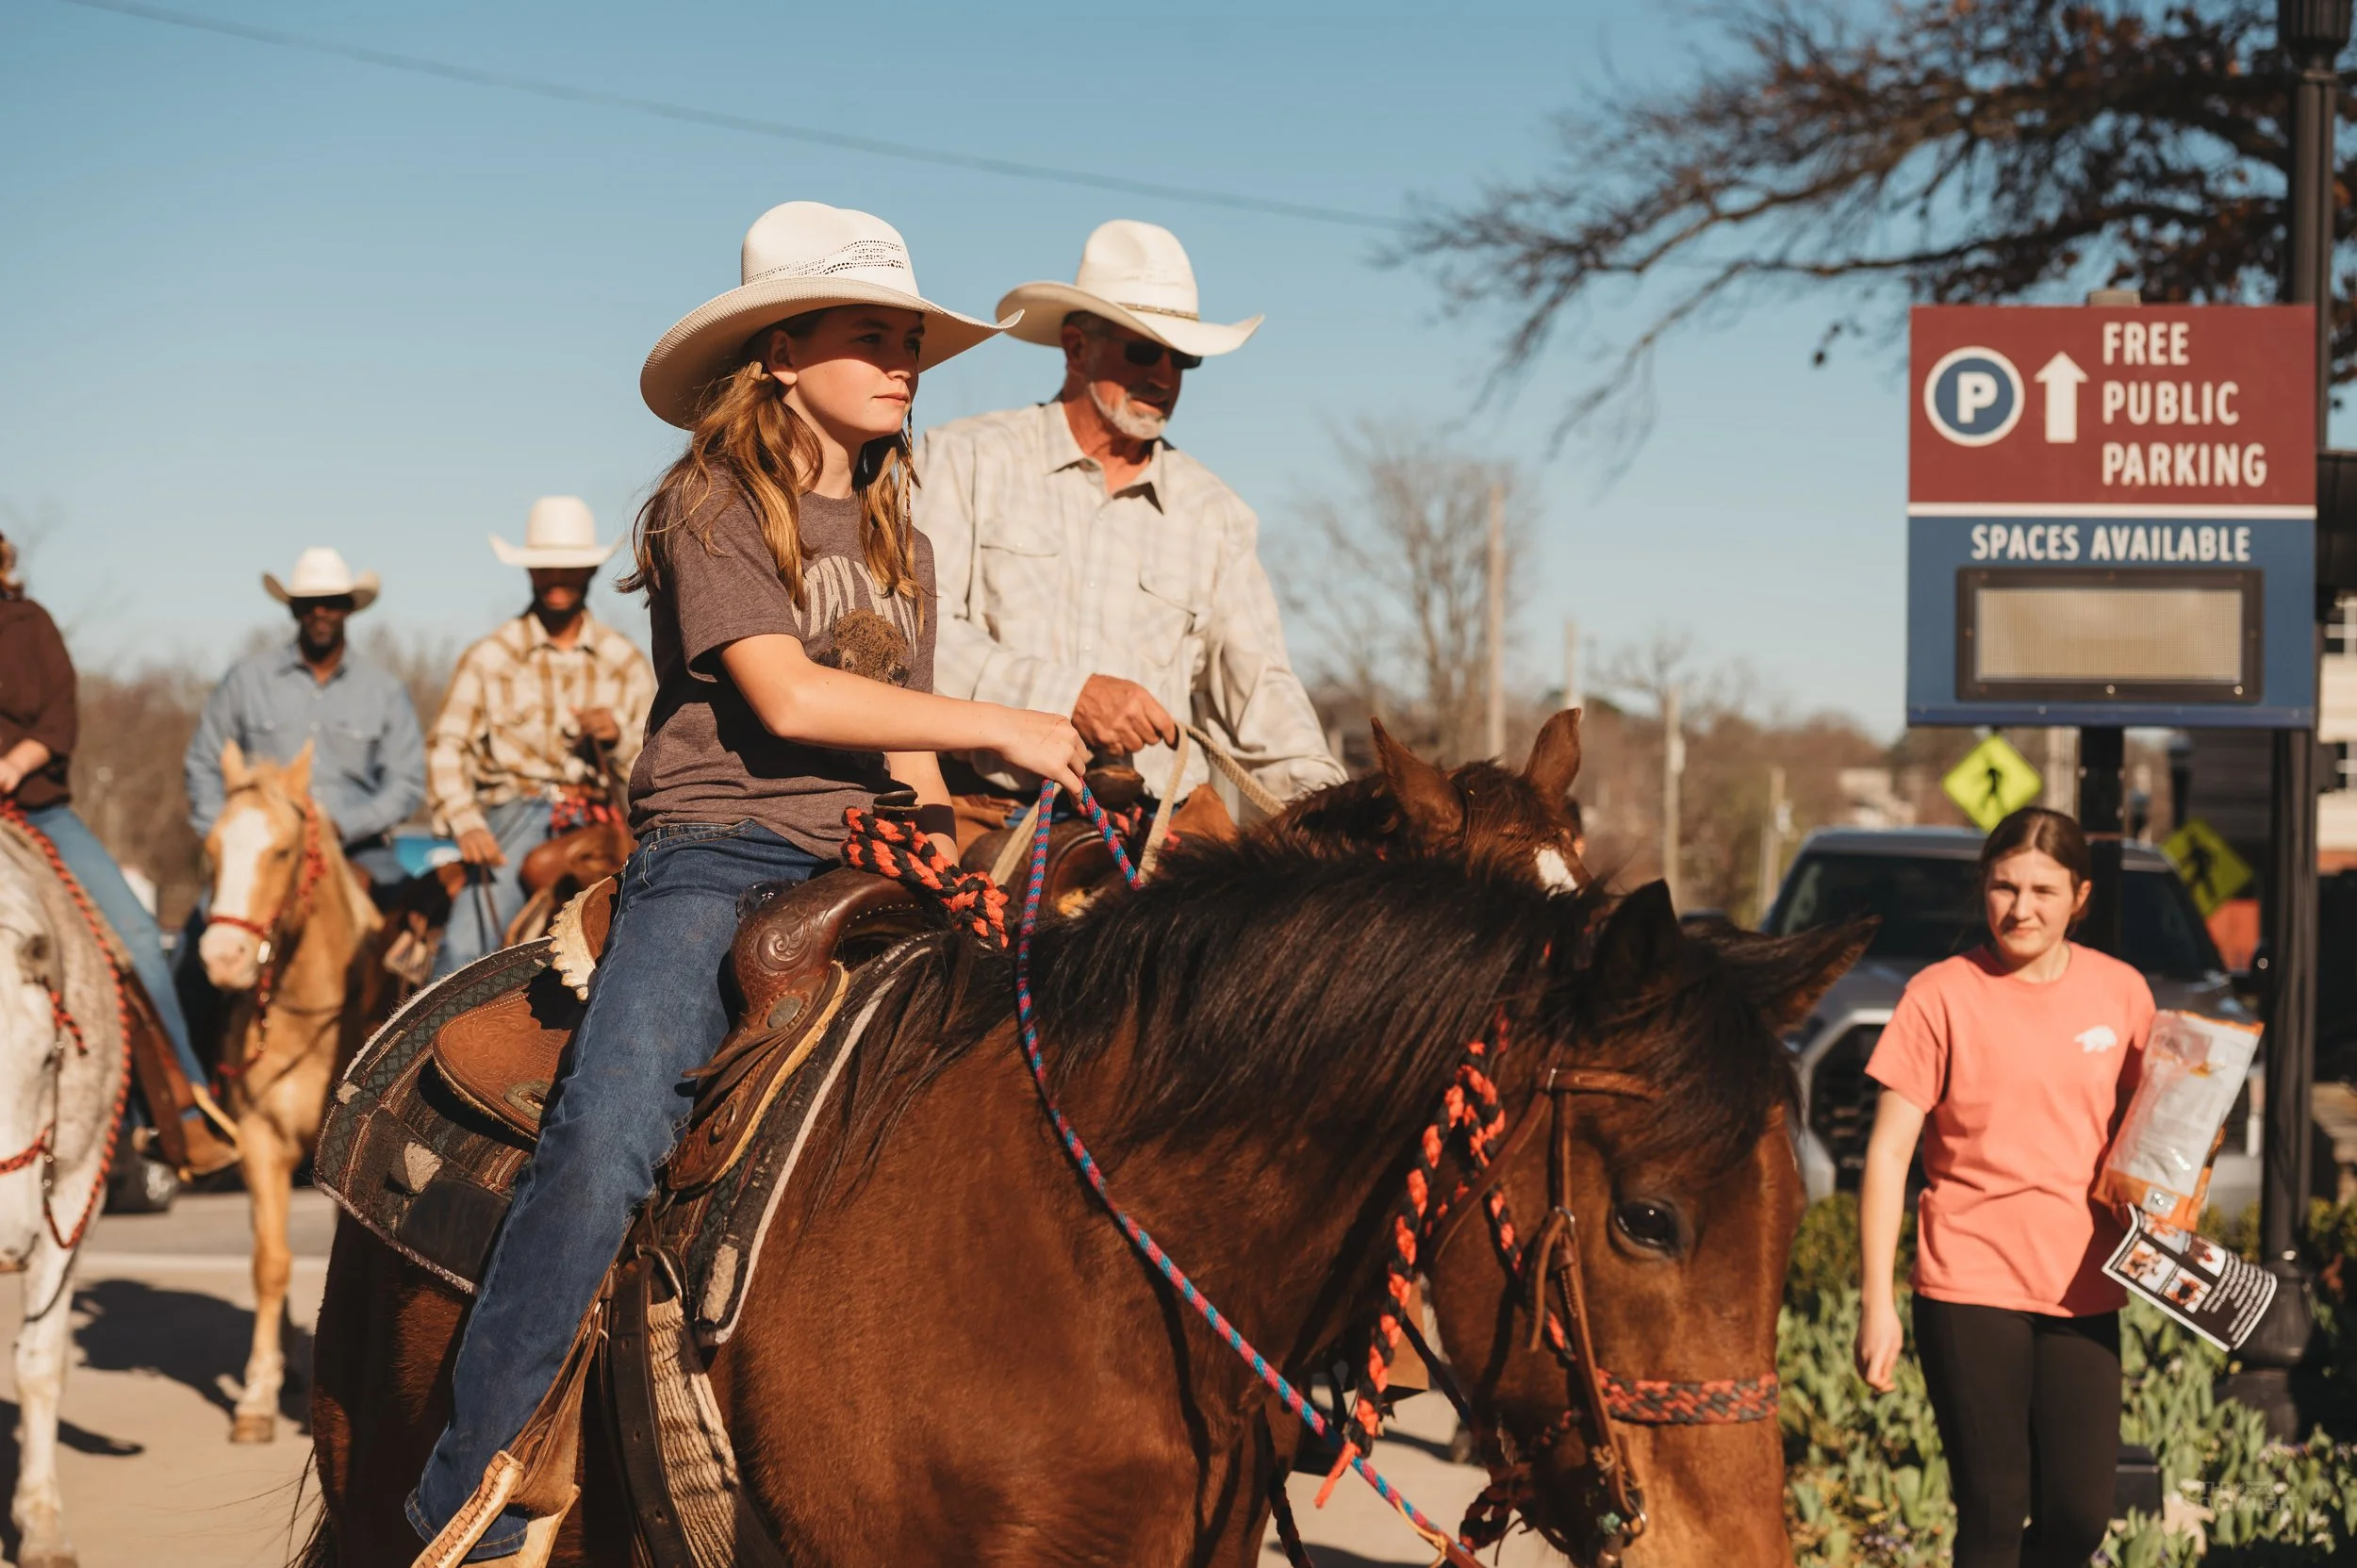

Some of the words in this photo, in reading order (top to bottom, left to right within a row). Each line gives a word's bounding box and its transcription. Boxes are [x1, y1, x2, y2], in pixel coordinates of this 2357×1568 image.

[2102, 322, 2190, 365] FREE
[1956, 371, 1999, 424] P
[2102, 381, 2239, 425] PUBLIC
[2102, 442, 2267, 487] PARKING
[1970, 524, 2080, 561] SPACES
[2090, 525, 2251, 562] AVAILABLE
